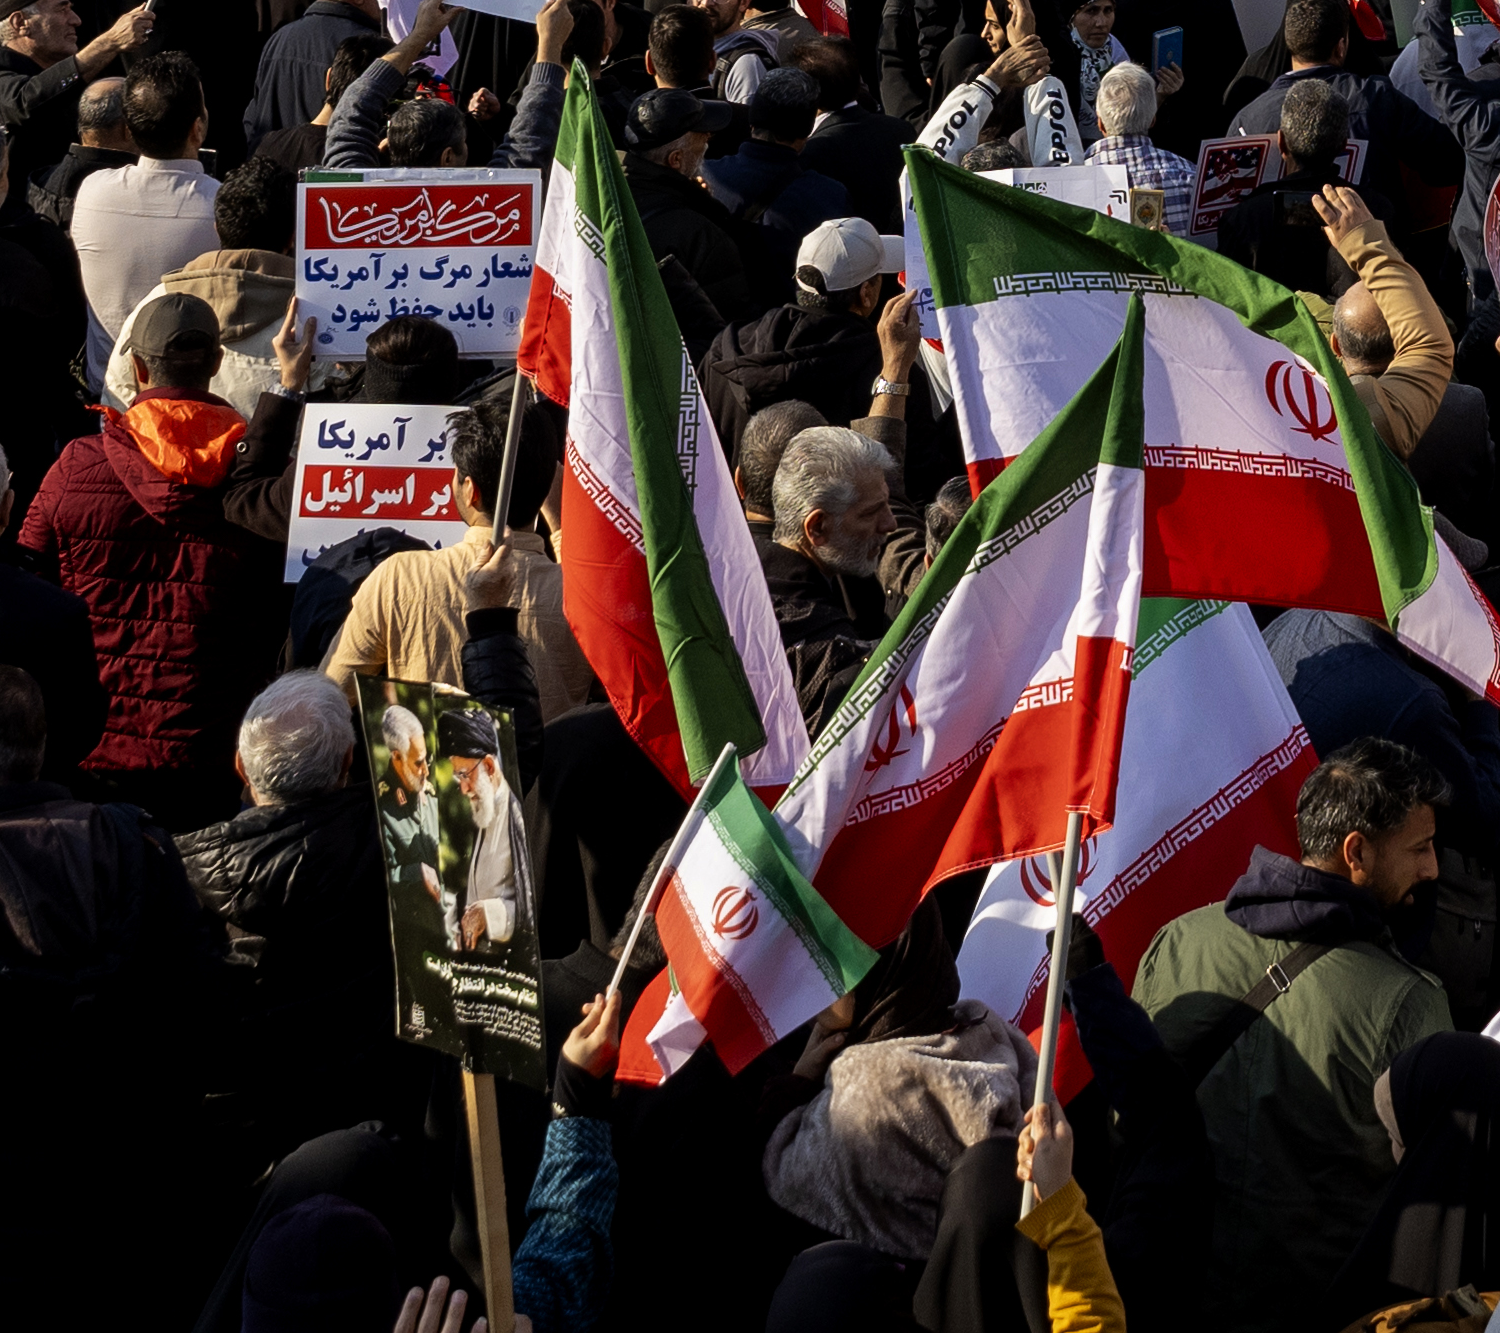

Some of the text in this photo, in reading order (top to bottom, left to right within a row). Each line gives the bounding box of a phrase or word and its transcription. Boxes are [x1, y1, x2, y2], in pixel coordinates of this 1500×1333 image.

[930, 99, 980, 159] PSOL
[1047, 87, 1070, 165] EPSOL
[303, 250, 534, 290] شعار مرگ بر آمریکا
[331, 298, 381, 332] شود
[447, 295, 495, 330] باید
[316, 416, 448, 463] بر آمریکا
[304, 468, 452, 517] بر اسرائیل
